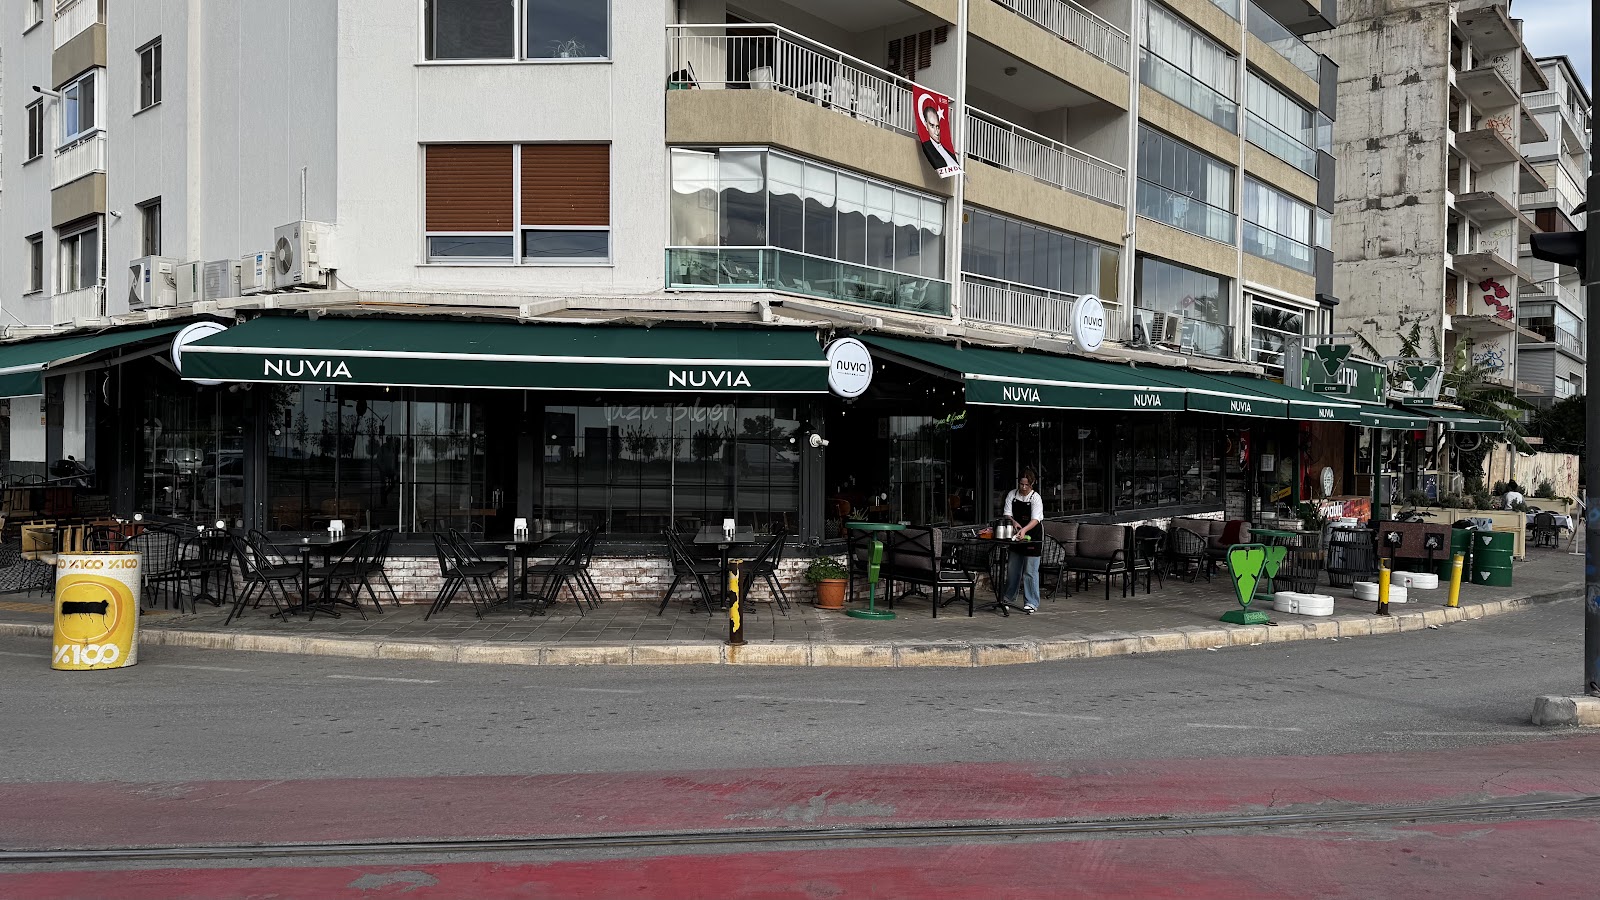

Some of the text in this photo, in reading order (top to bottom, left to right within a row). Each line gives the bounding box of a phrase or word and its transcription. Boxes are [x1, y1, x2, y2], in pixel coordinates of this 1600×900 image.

[1084, 315, 1103, 327] nuvia
[263, 358, 353, 378] NUVIA
[836, 360, 867, 373] nuvia
[668, 369, 752, 387] NUVIA
[1003, 386, 1041, 402] NUVIA
[1133, 394, 1162, 406] NUVIA
[1230, 400, 1252, 413] NUVIA
[1318, 408, 1335, 418] NUVIA
[108, 559, 138, 569] %100
[54, 643, 120, 665] %100
